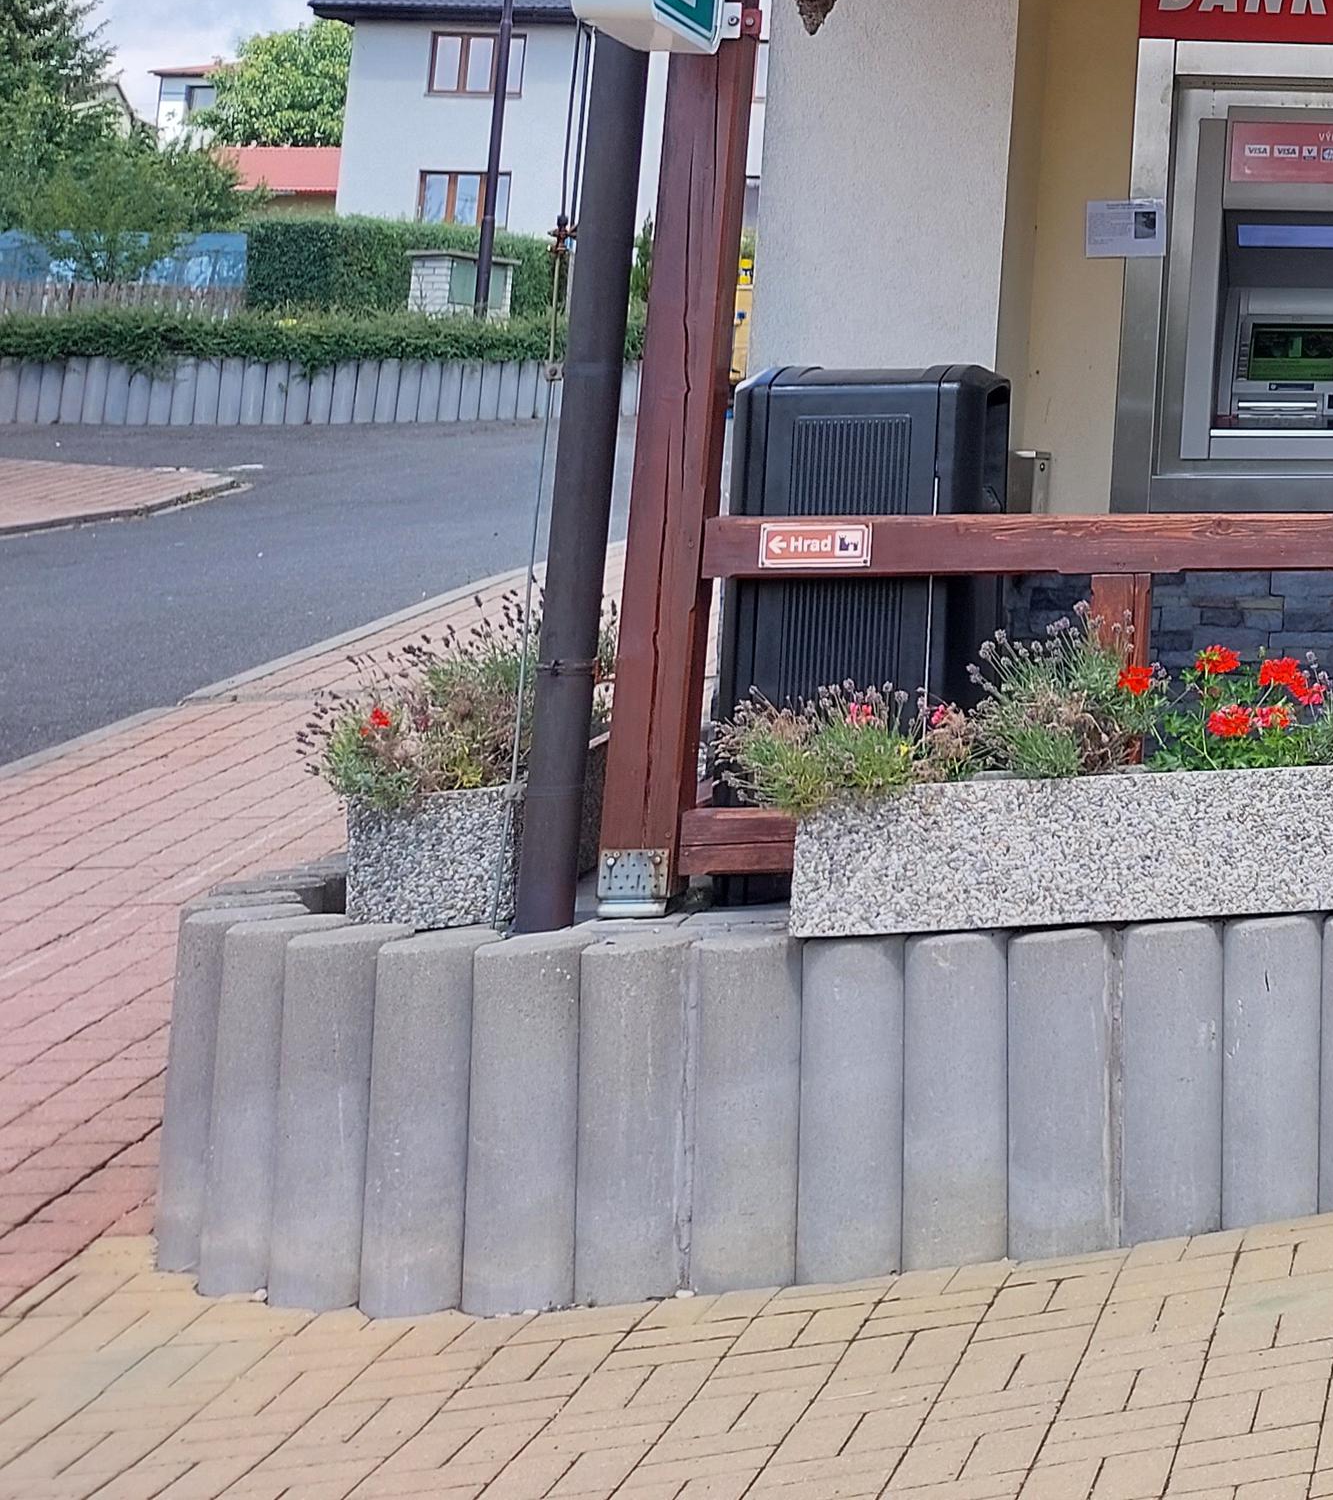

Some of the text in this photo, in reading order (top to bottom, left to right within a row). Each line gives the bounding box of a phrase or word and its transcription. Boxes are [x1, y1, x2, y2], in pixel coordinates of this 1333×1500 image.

[1248, 146, 1267, 156] VISA
[1277, 147, 1297, 156] VISA
[789, 535, 832, 553] Hrad
